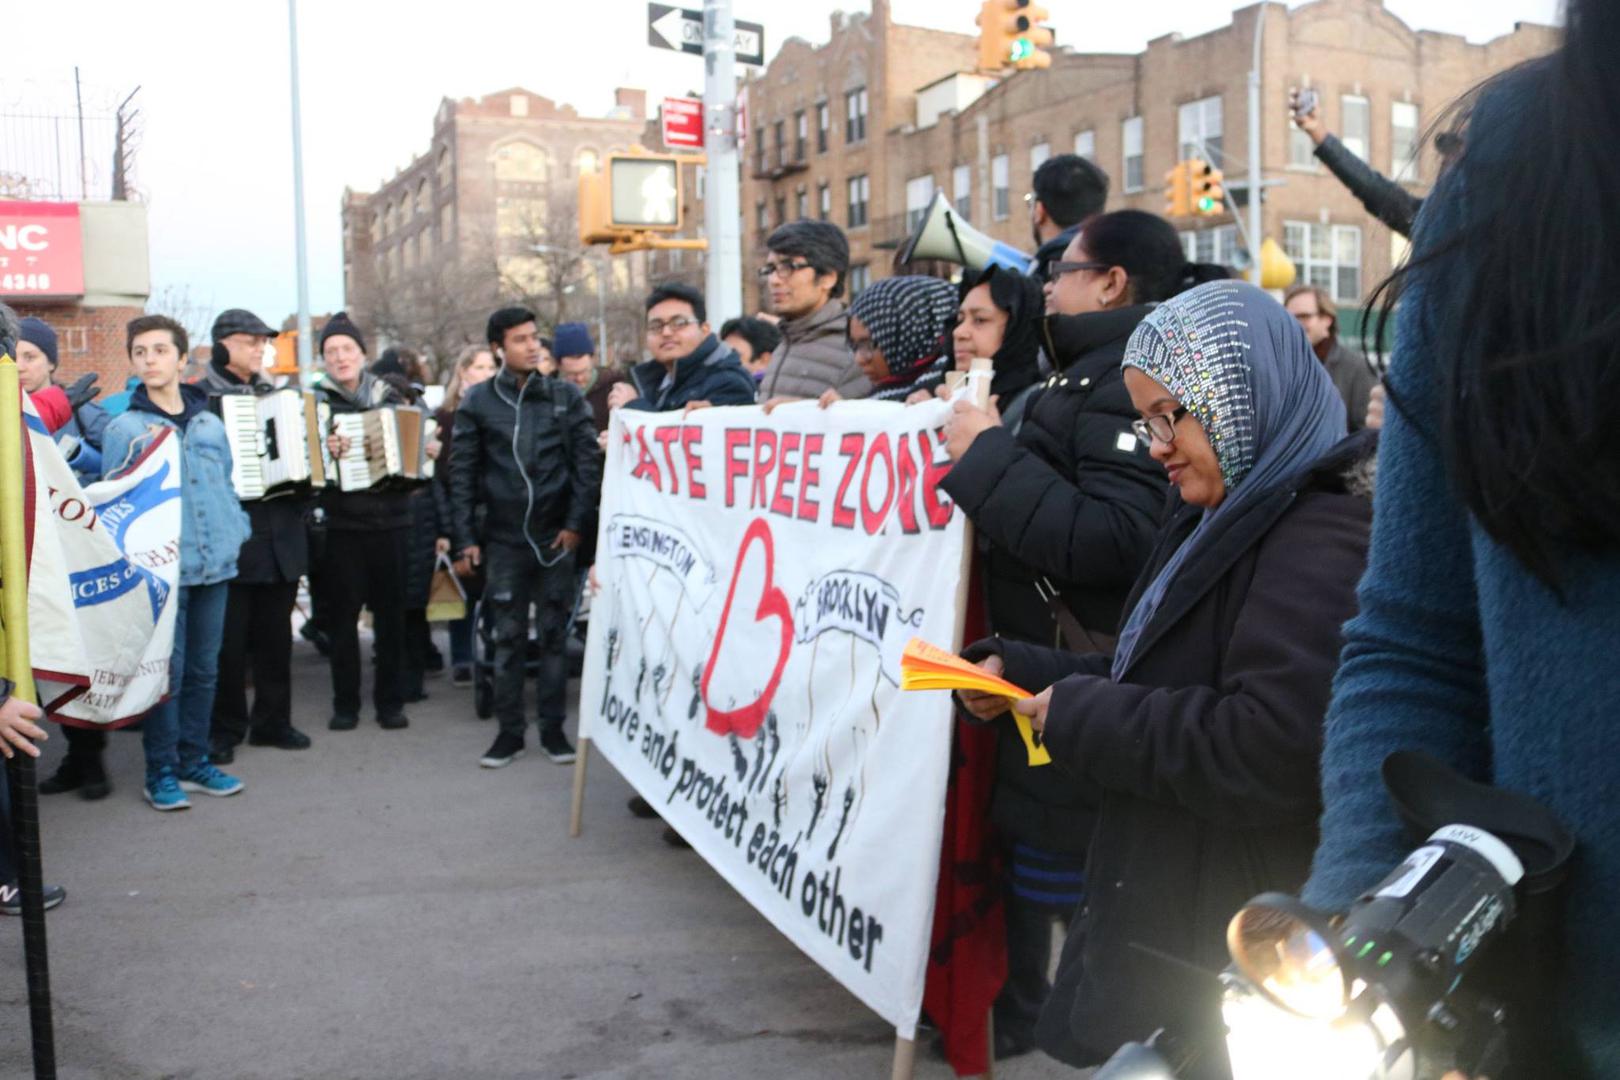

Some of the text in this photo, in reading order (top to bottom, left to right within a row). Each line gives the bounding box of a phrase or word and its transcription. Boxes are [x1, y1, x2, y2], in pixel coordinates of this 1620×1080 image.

[683, 22, 704, 41] ON
[621, 422, 955, 536] ATE FREE ZONE
[618, 524, 697, 578] ENSINGTON
[71, 572, 121, 600] ICES
[600, 675, 883, 973] love and protect each other
